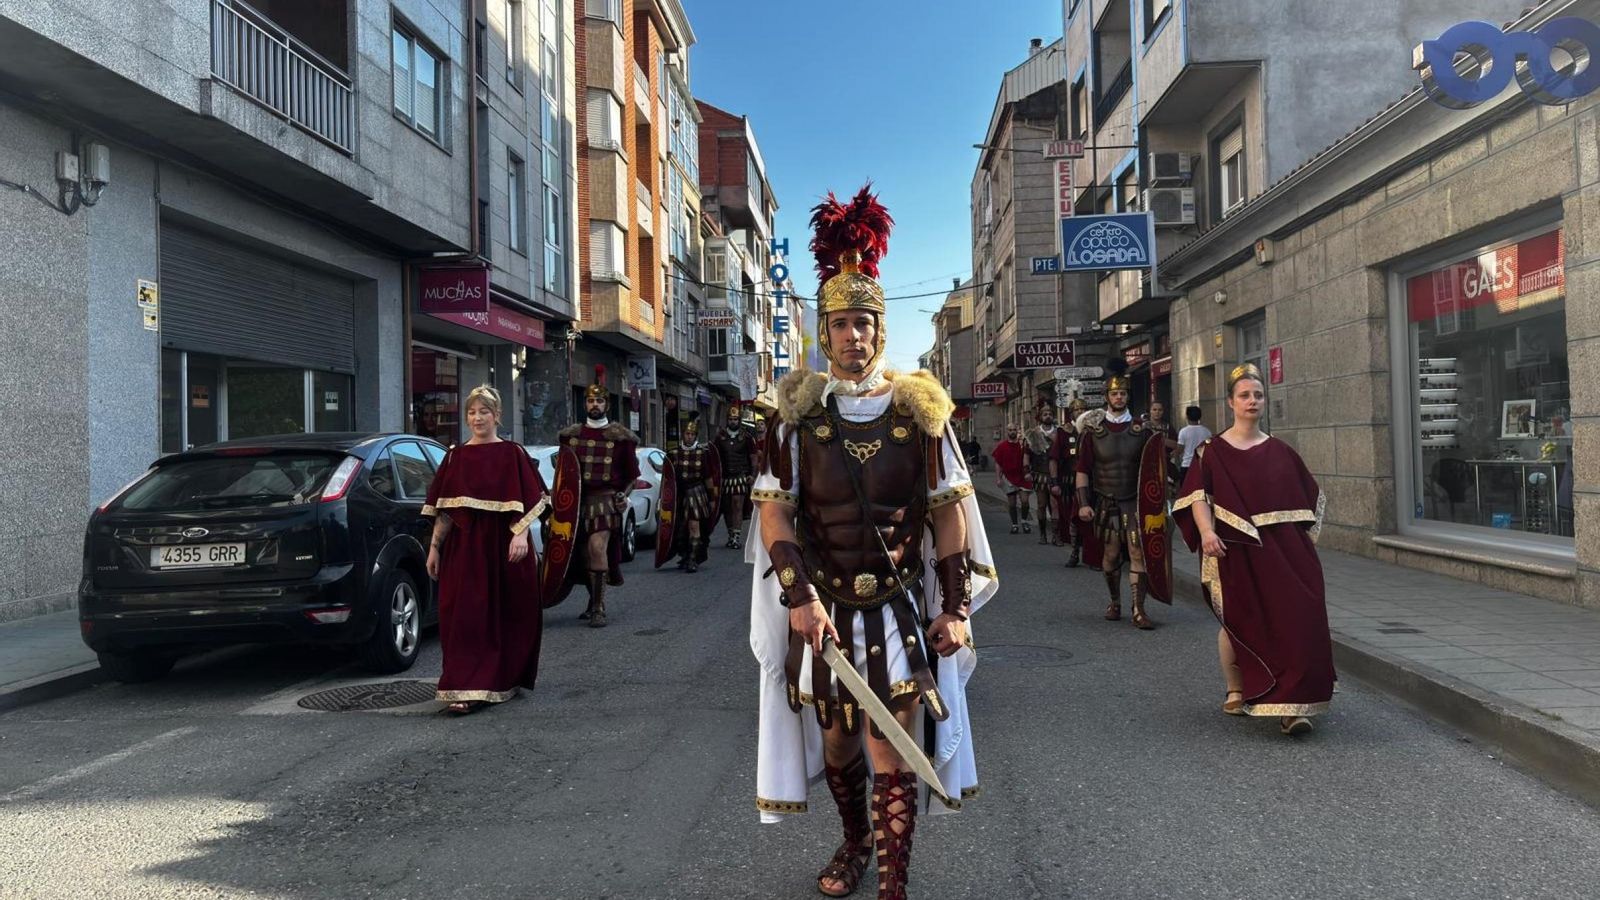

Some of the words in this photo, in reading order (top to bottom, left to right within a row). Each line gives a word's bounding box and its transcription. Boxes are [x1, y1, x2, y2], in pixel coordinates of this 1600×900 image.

[1047, 142, 1084, 156] AUTO
[1059, 161, 1072, 218] ESCU
[1089, 227, 1122, 237] centro
[1067, 247, 1147, 266] LOSADA
[1035, 258, 1057, 271] PTE.
[1463, 256, 1514, 299] GAES
[424, 280, 482, 303] MUCHAS
[769, 238, 790, 359] HOTEL
[699, 309, 734, 318] MUEBLES
[698, 317, 735, 328] JOSMARY
[1018, 342, 1072, 355] GALICIA
[1026, 355, 1065, 366] MODA
[975, 384, 1003, 394] FROIZ
[163, 546, 202, 563] 4355
[208, 545, 239, 561] GRR
